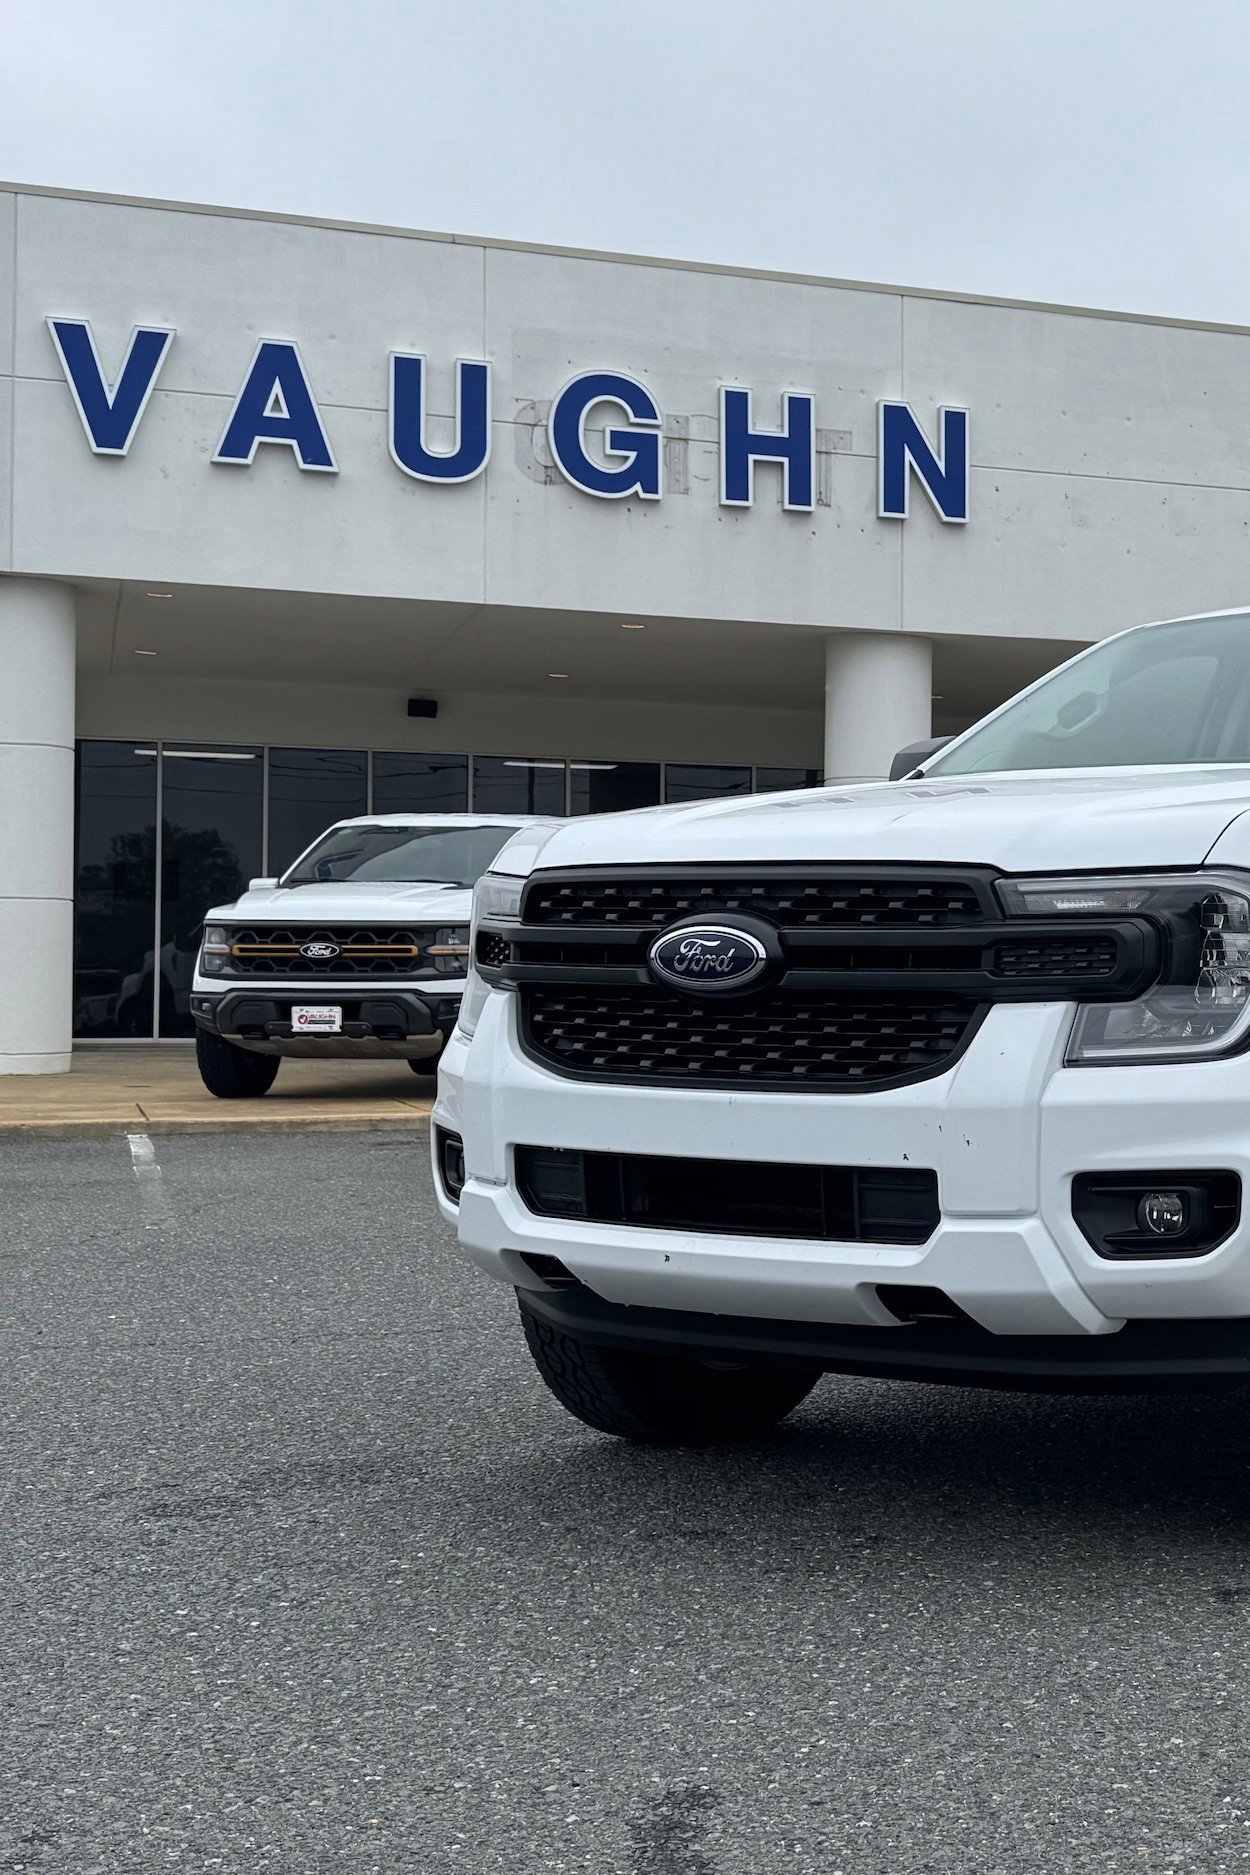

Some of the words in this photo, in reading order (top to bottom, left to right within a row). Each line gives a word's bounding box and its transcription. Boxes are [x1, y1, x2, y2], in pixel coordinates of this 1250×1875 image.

[45, 316, 970, 524] VAUGHN
[307, 944, 332, 955] Ford
[673, 938, 736, 972] Ford
